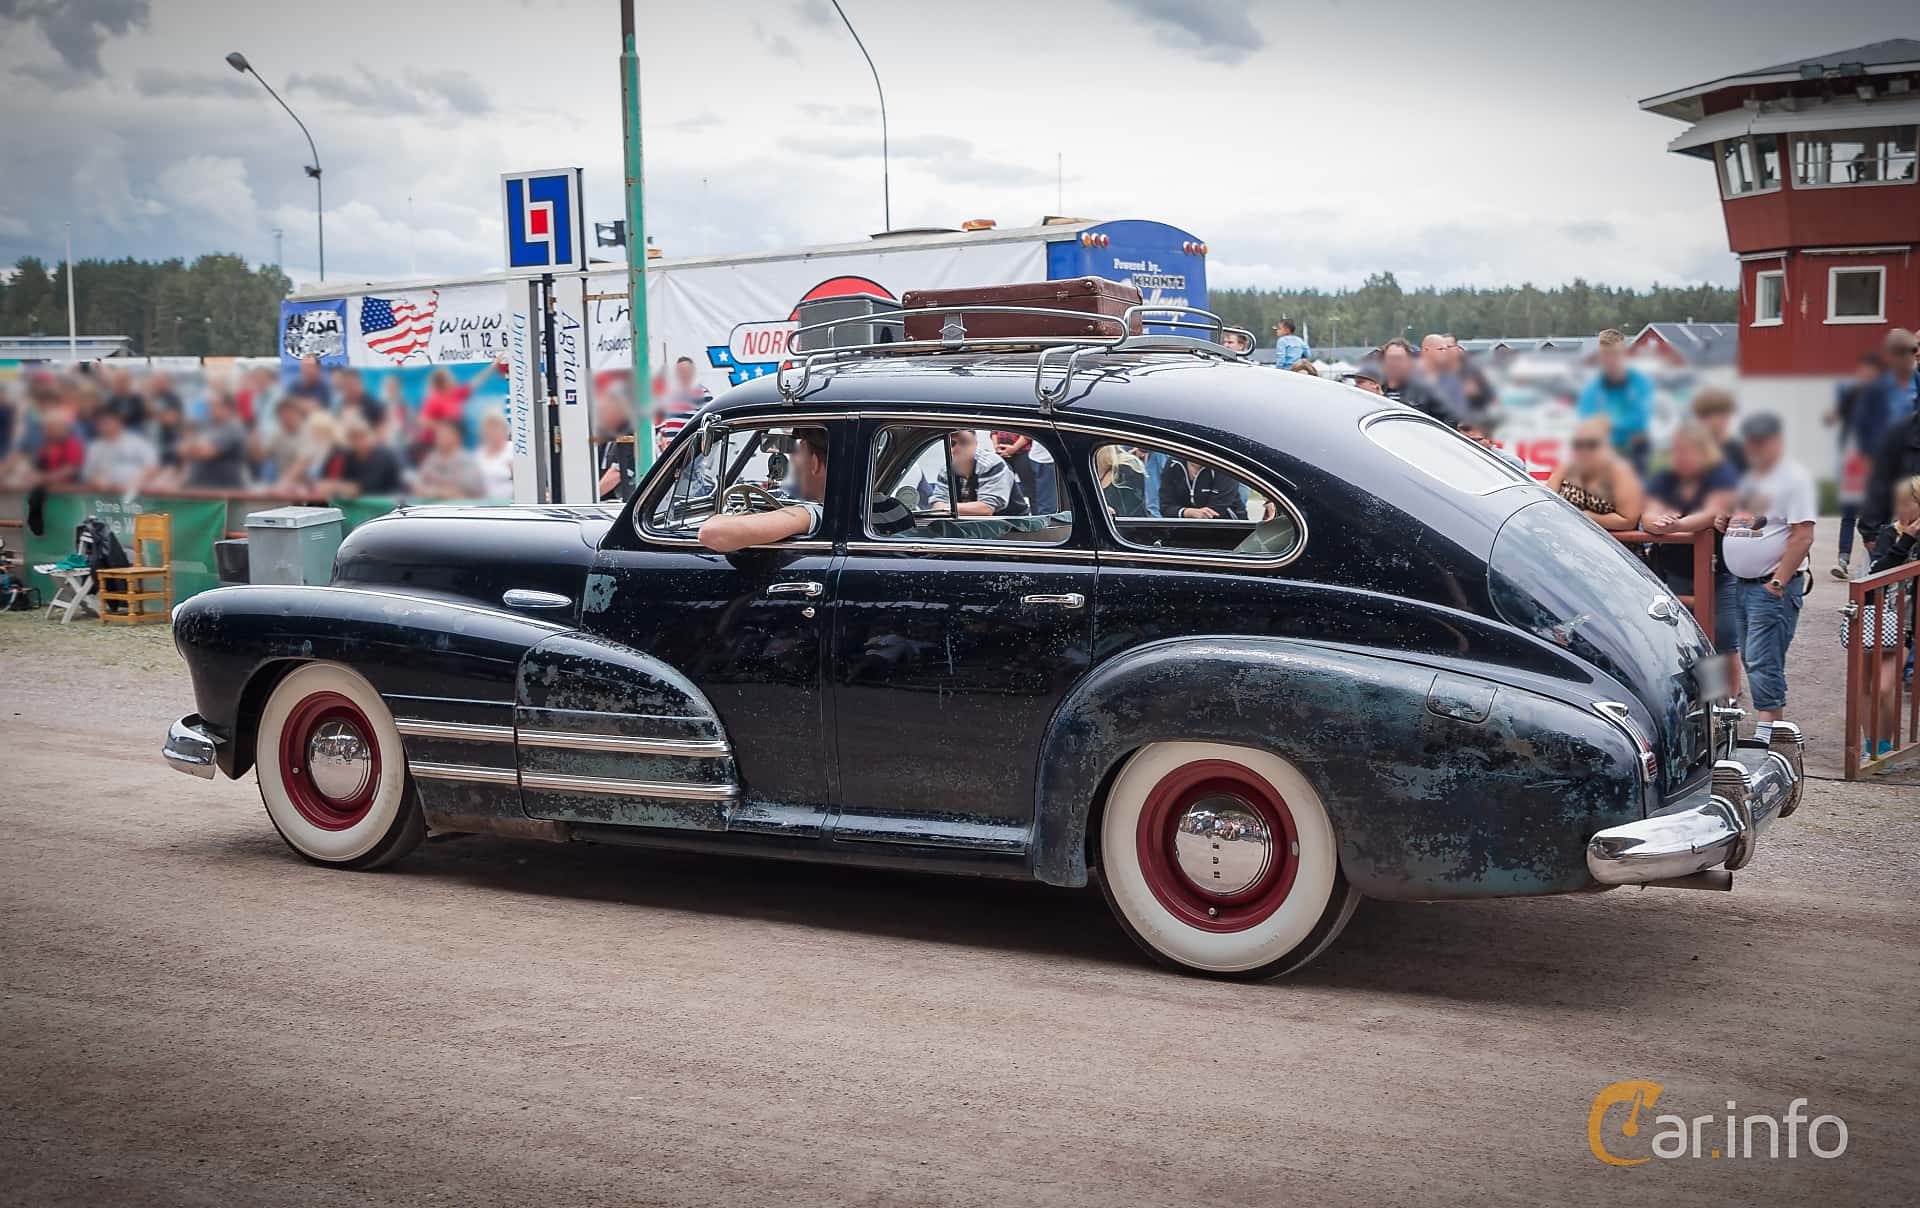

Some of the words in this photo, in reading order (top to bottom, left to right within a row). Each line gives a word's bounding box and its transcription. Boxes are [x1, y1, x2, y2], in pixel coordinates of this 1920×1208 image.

[1132, 273, 1185, 289] KRANTZ
[481, 332, 493, 348] 12
[559, 311, 581, 384] Agria
[511, 313, 529, 456] Djurförsäkring
